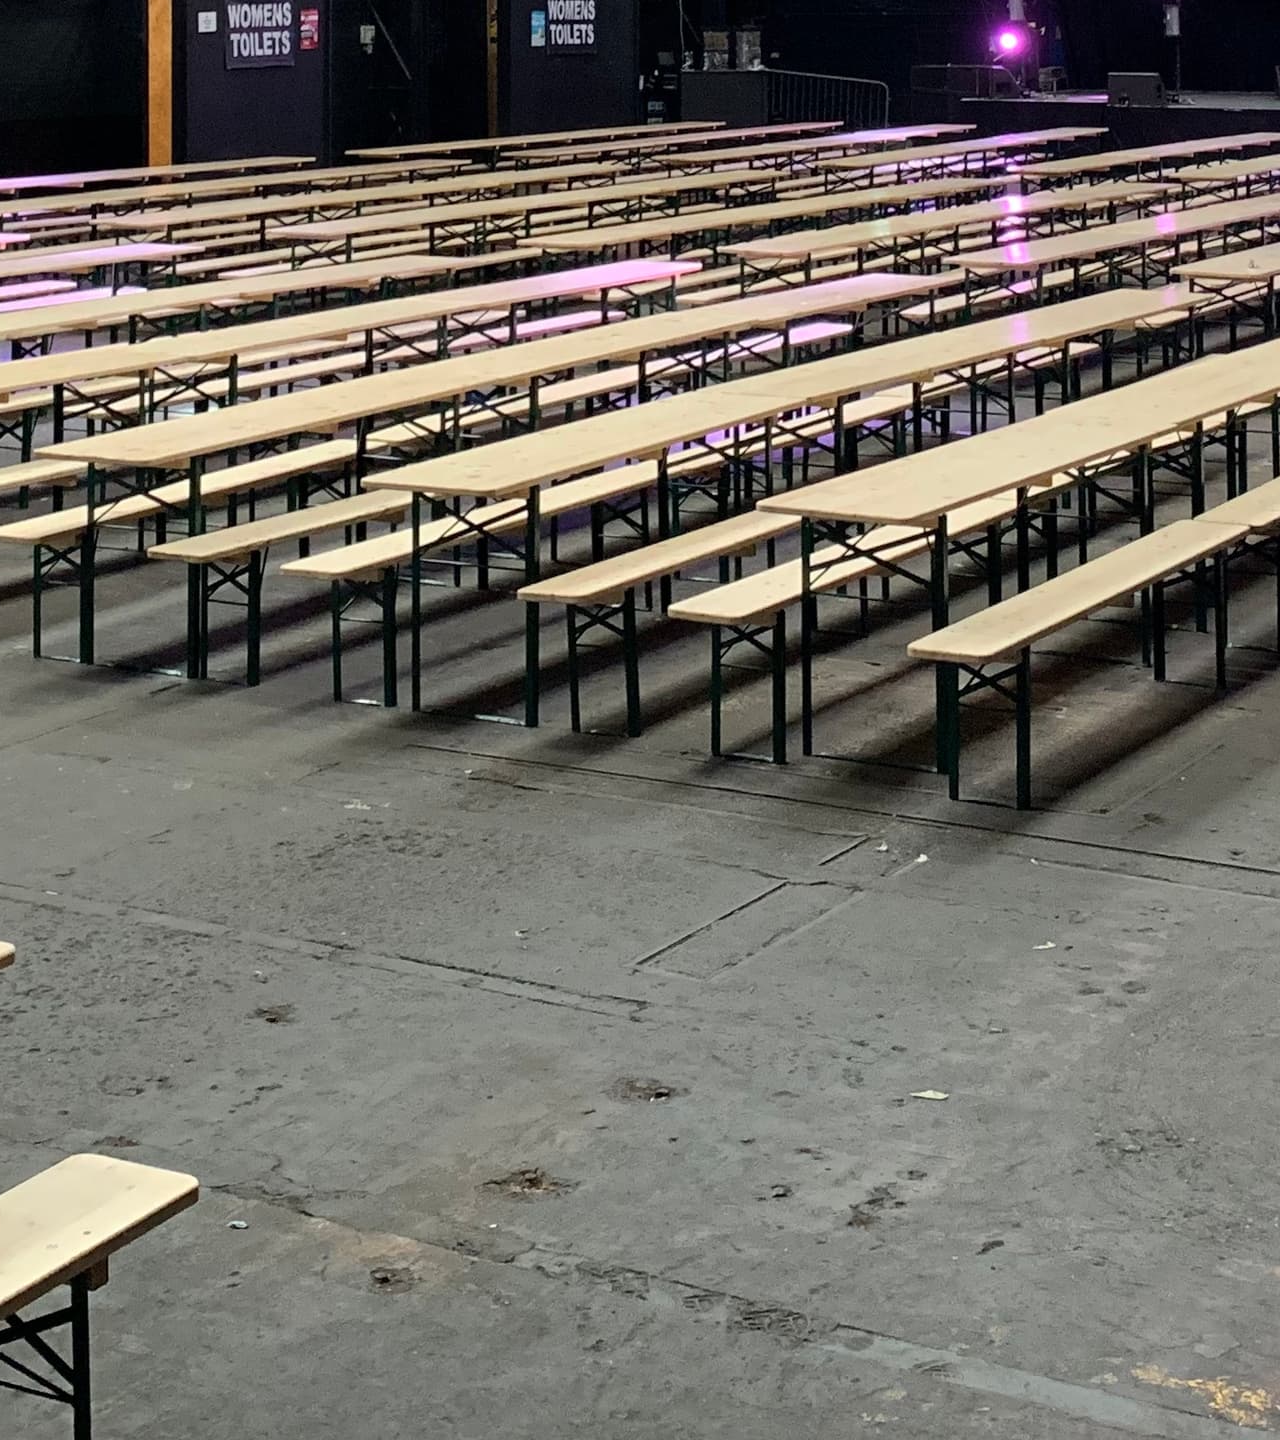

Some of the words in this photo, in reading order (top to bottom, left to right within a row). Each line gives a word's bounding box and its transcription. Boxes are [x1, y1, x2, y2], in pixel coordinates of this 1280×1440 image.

[227, 2, 292, 29] WOMENS
[547, 0, 596, 20] WOMENS
[230, 30, 291, 58] TOILETS
[549, 23, 595, 45] TOILETS
